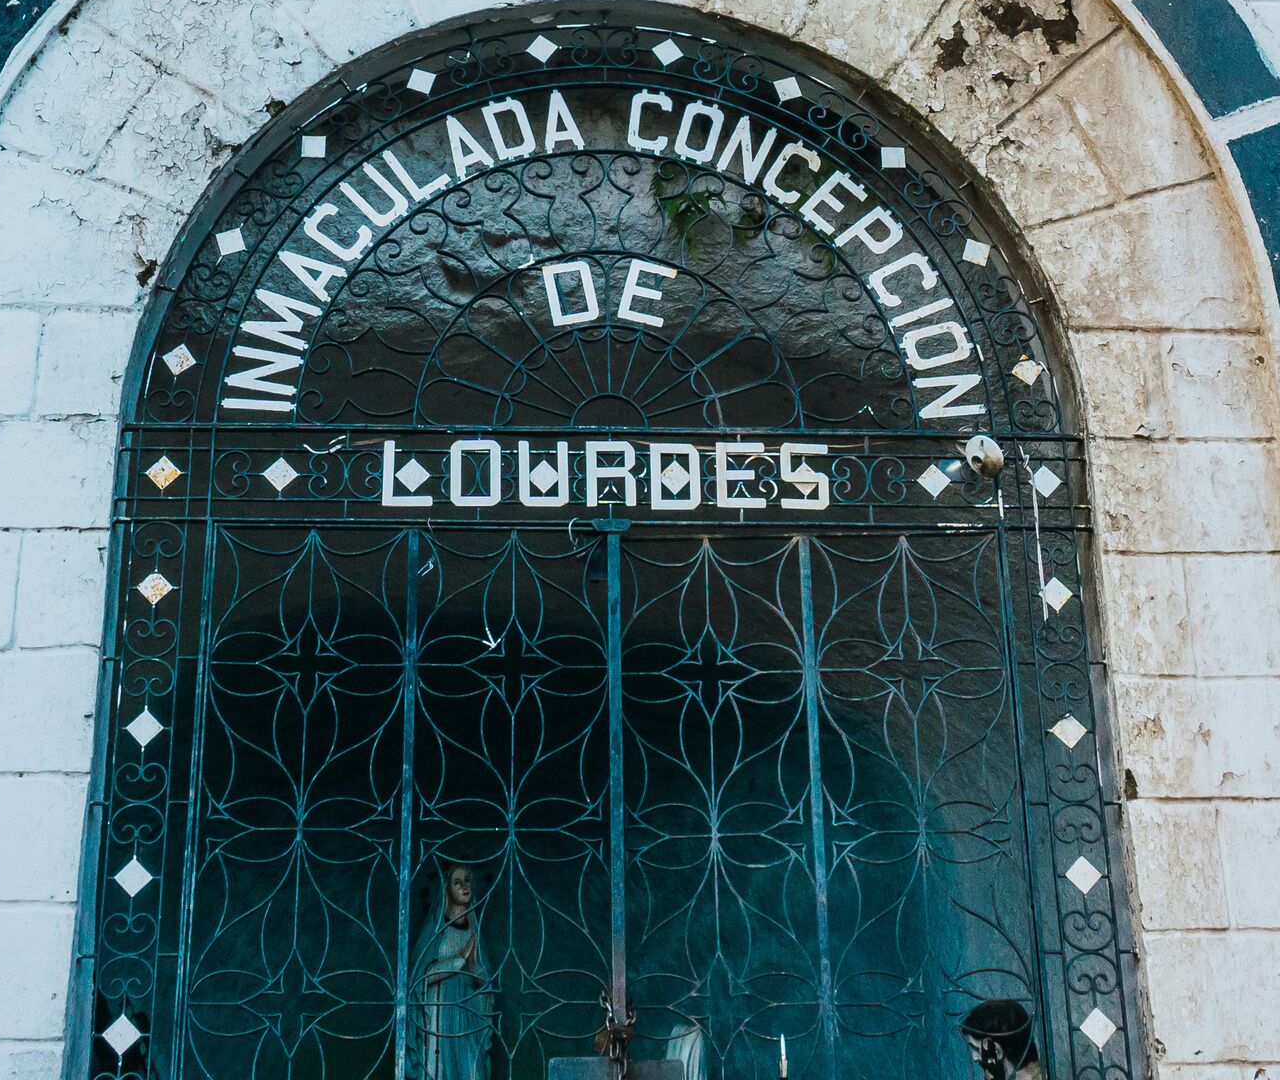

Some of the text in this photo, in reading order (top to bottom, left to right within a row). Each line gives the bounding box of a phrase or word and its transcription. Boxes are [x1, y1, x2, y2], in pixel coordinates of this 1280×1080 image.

[221, 89, 986, 419] INMACULADA CONCEPCION
[542, 259, 677, 327] DE
[382, 440, 829, 510] LOURDES
